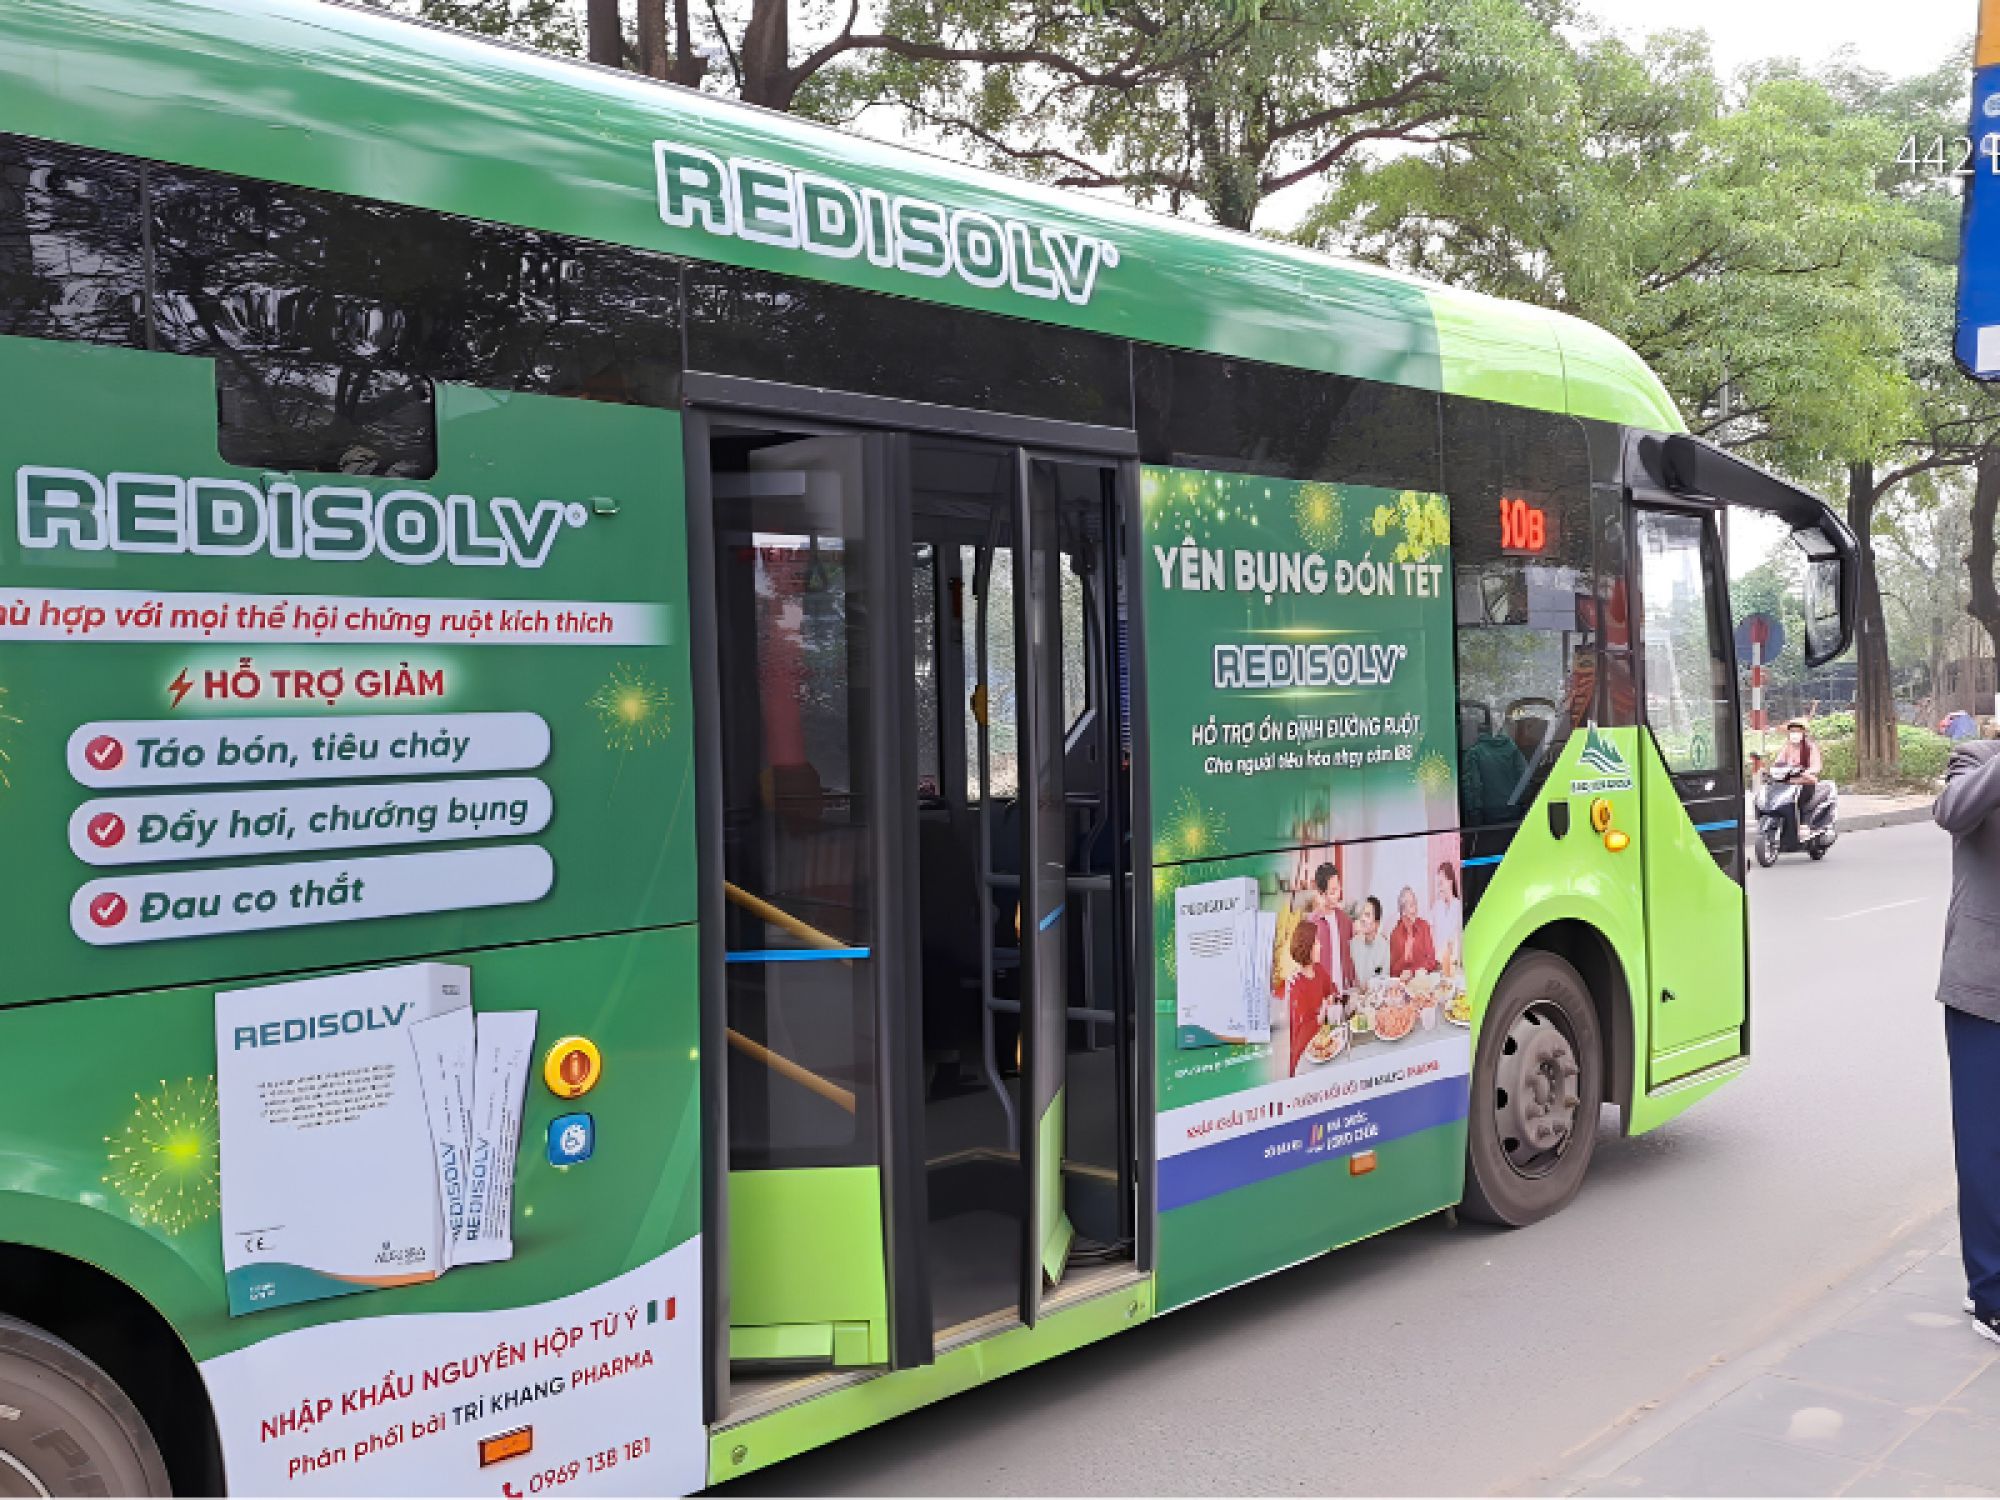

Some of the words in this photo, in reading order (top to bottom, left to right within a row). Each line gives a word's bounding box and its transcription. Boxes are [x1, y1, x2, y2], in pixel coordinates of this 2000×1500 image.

[1152, 535, 1225, 591] YÊN
[1234, 550, 1328, 605] BỤNG
[1335, 550, 1395, 597] ĐÓN
[40, 600, 105, 634] hợp
[115, 602, 164, 628] với
[170, 603, 229, 636] mọi
[237, 600, 289, 628] thể
[293, 605, 338, 637] hội
[345, 606, 431, 637] chứng
[440, 610, 494, 638] ruột
[500, 609, 548, 633] kích
[556, 611, 613, 633] thích
[203, 656, 261, 698] HỖ
[271, 667, 344, 707] TRỢ
[355, 661, 445, 697] GIẢM
[137, 736, 206, 769] Táo
[217, 734, 298, 767] bón,
[312, 733, 379, 761] tiêu
[389, 728, 470, 762] chảy
[229, 807, 295, 841] hơi,
[309, 800, 438, 833] chướng
[448, 796, 528, 831] bụng
[140, 891, 221, 923] Đau
[233, 889, 276, 914] co
[290, 872, 364, 909] thắt
[234, 1003, 407, 1051] REDISOLV
[260, 1397, 333, 1443] NHẬP
[341, 1368, 414, 1416] KHẨU
[423, 1341, 526, 1391] NGUYÊN
[534, 1325, 583, 1359] HỘP
[591, 1312, 619, 1342] TỪ
[624, 1306, 639, 1330] Ý
[288, 1447, 346, 1480] Phân
[354, 1424, 405, 1458] phối
[411, 1412, 446, 1440] bởi
[491, 1376, 566, 1414] KHANG
[572, 1349, 654, 1390] PHARMA
[529, 1460, 580, 1494] 0969
[586, 1447, 618, 1474] 138
[624, 1436, 652, 1462] 181
